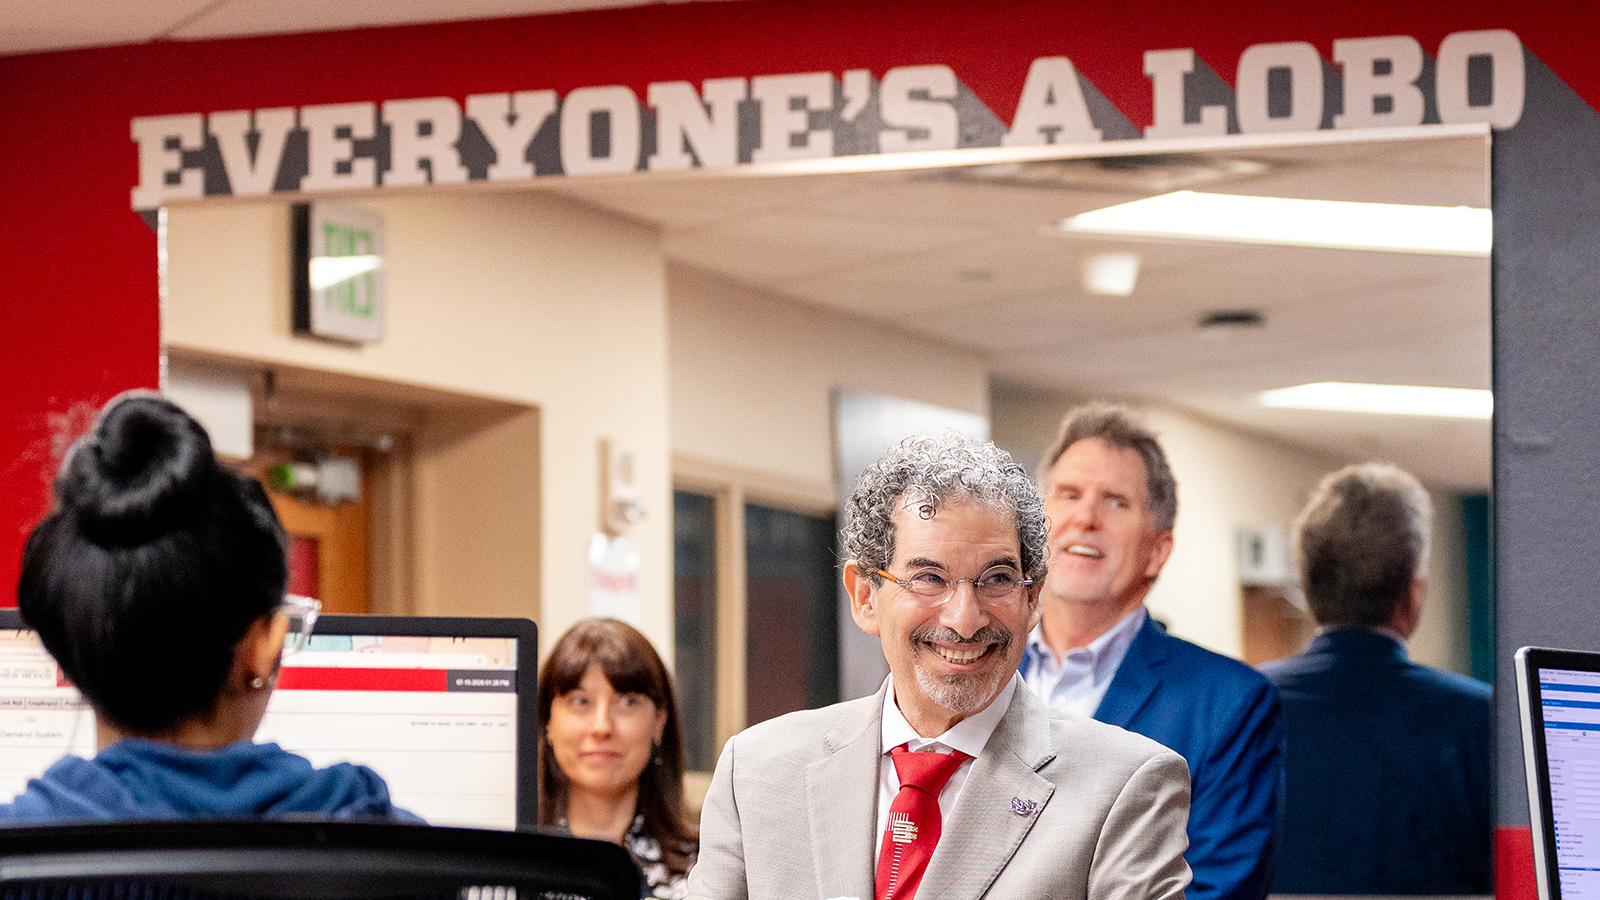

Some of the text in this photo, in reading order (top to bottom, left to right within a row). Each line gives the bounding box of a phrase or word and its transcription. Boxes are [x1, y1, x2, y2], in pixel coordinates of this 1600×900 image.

[130, 28, 1525, 210] EVERYONE'S A LOBO
[34, 730, 63, 739] System
